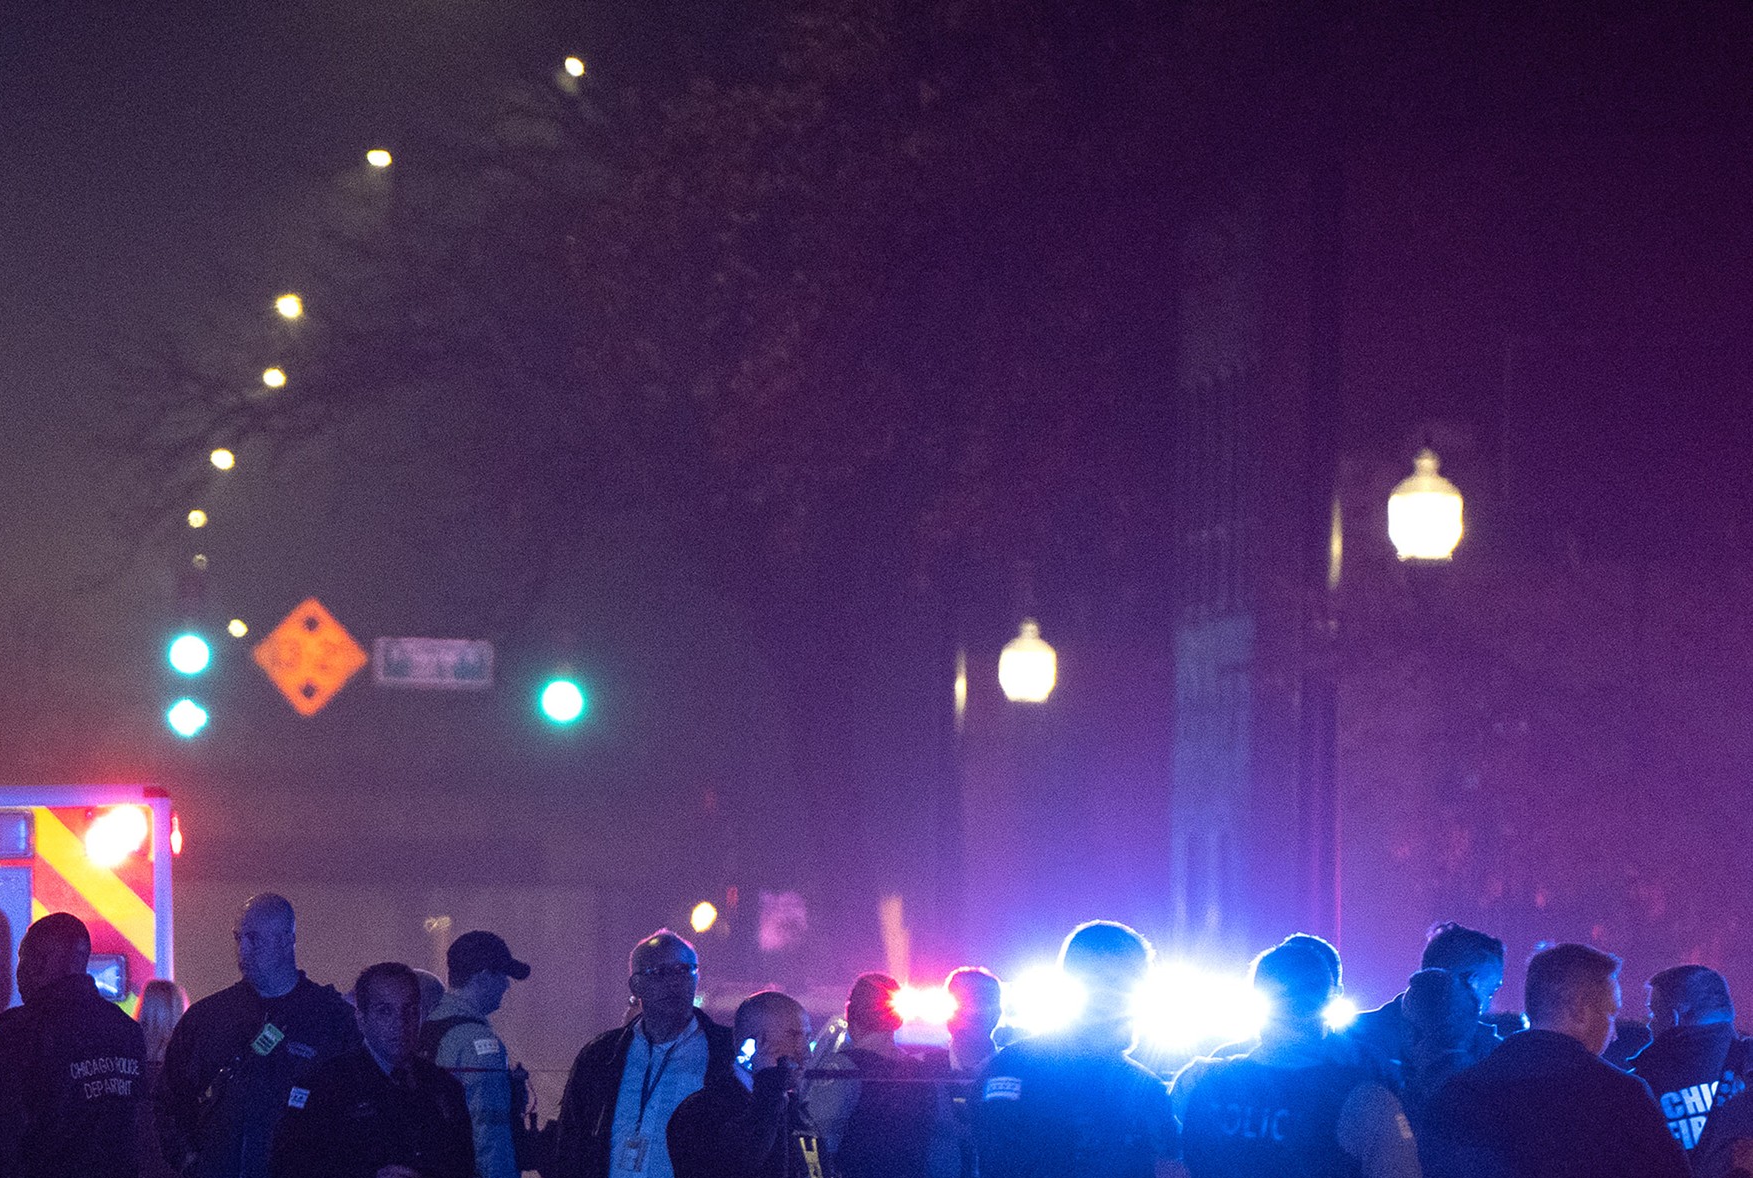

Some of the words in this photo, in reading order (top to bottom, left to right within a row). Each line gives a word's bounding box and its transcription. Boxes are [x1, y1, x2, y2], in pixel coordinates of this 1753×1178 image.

[70, 1057, 114, 1079] CHICAGO
[1209, 1102, 1302, 1142] OLIC
[1666, 1115, 1708, 1150] FIR
